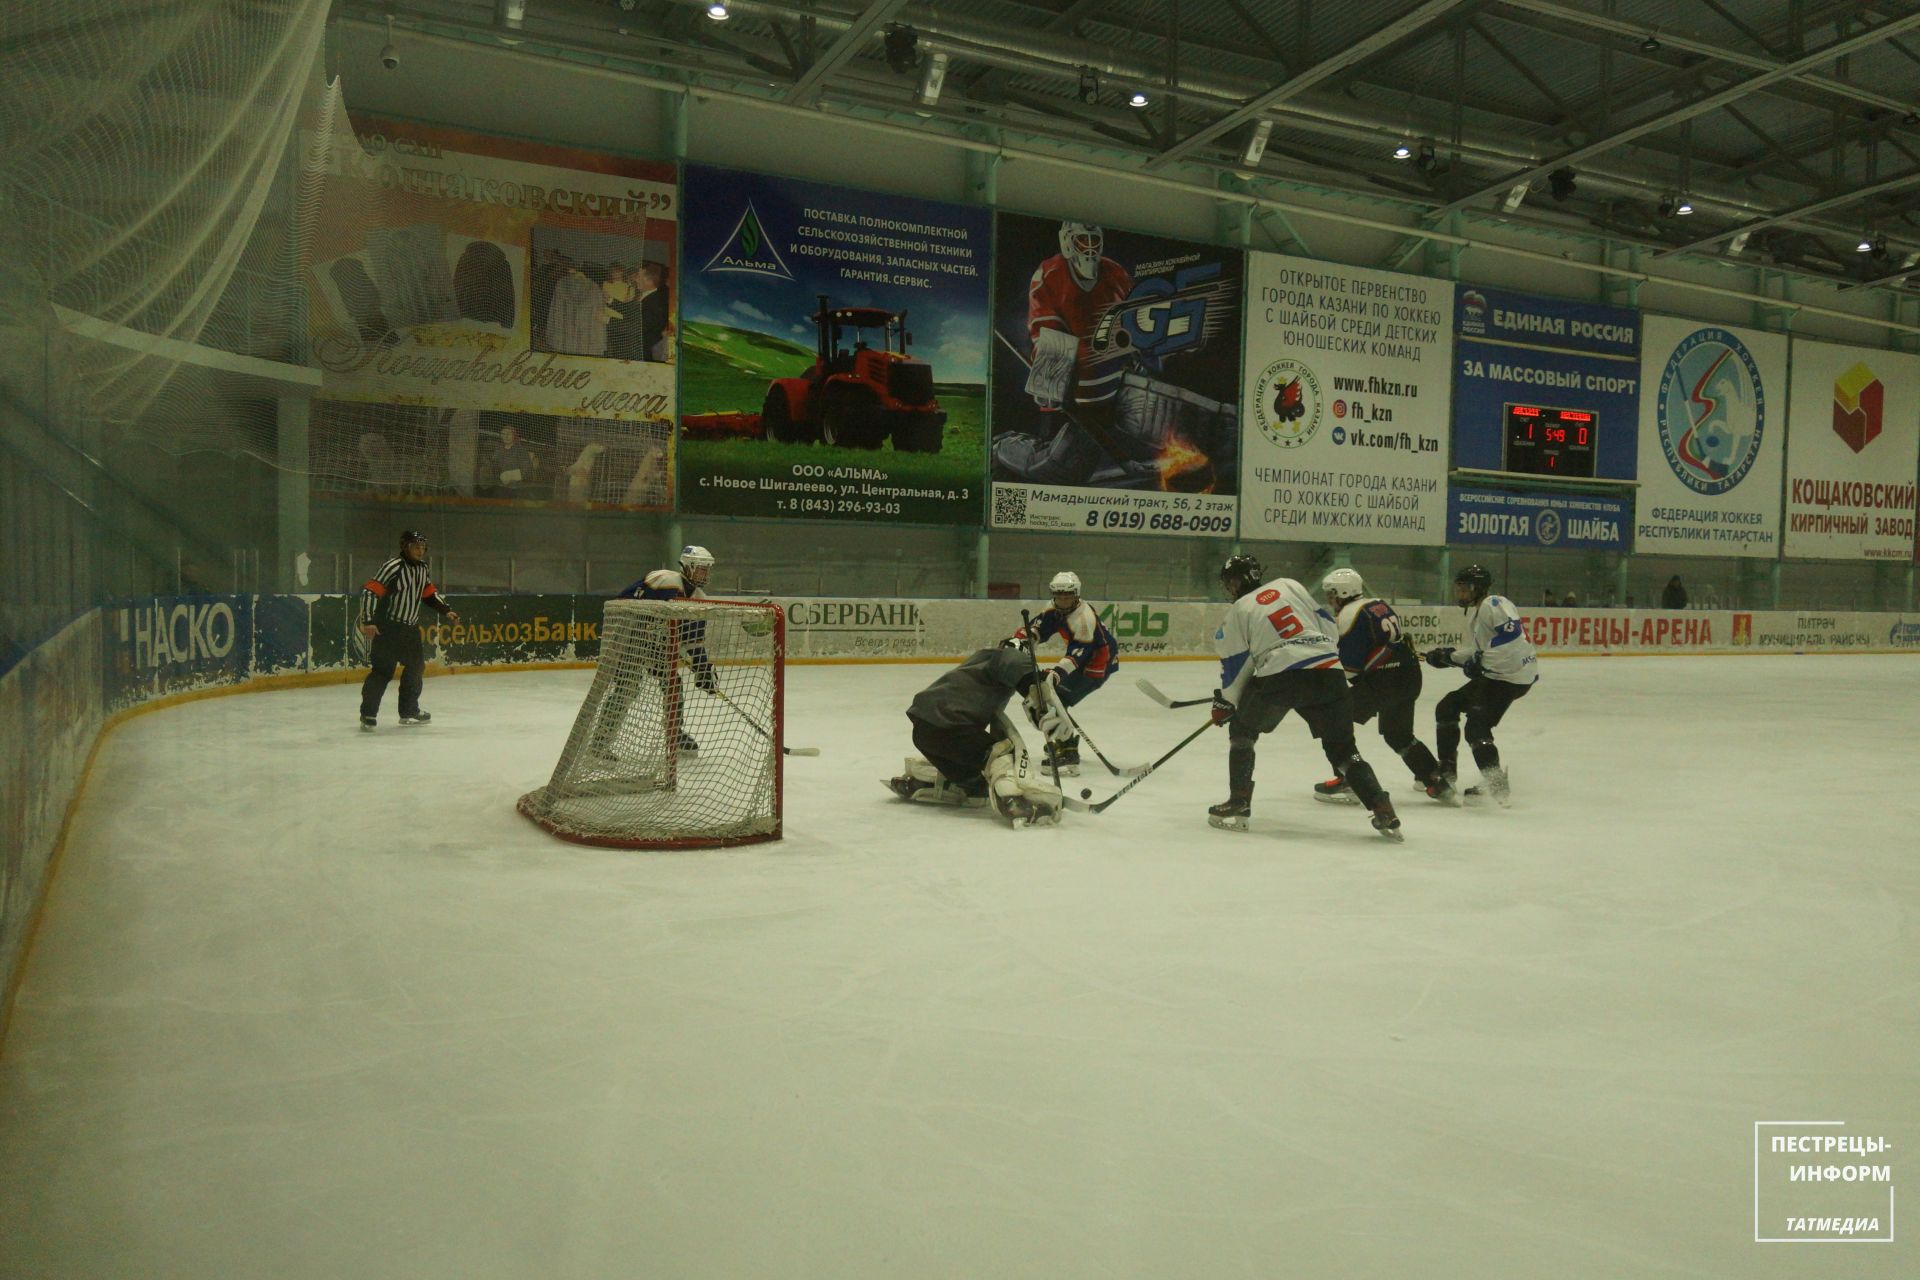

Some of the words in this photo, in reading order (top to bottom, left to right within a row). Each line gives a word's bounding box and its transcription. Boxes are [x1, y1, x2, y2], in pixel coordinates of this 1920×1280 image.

[804, 208, 857, 225] ПОСТАВКА
[859, 216, 968, 240] ПОЛНОКОМПЛЕКТНОЙ
[798, 226, 928, 251] СЕЛЬСКОХОЗЯЙСТВЕННОЙ
[930, 243, 972, 258] ТЕХНИКИ
[790, 243, 797, 254] И
[800, 244, 884, 265] ОБОРУДОВАНИЯ,
[886, 255, 939, 271] ЗАПАСНЫХ
[941, 262, 979, 277] ЧАСТЕЙ.
[840, 268, 891, 283] ГАРАНТИЯ.
[893, 275, 932, 289] СЕРВИС.
[1280, 269, 1346, 293] ОТКРЫТОЕ
[1352, 280, 1426, 304] ПЕРВЕНСТВО
[1262, 286, 1314, 308] ГОРОДА
[1319, 295, 1367, 316] КАЗАНИ
[1372, 303, 1389, 319] ПО
[1394, 306, 1440, 325] ХОККЕЮ
[1266, 308, 1273, 323] С
[1279, 310, 1336, 330] ШАЙБОЙ
[1341, 318, 1380, 337] СРЕДИ
[1385, 324, 1437, 344] ДЕТСКИХ
[1493, 309, 1565, 335] ЕДИНАЯ
[1571, 321, 1633, 344] РОССИЯ
[1283, 330, 1366, 354] ЮНОШЕСКИХ
[1371, 343, 1420, 362] КОМАНД
[1334, 376, 1418, 398] www.fhkzn.ru
[1463, 360, 1484, 378] ЗА
[1489, 363, 1581, 389] МАССОВЫЙ
[1585, 375, 1636, 395] СПОРТ
[1352, 401, 1392, 423] fh_kzn
[1350, 429, 1438, 453] vk.com/fh_kzn
[1578, 427, 1588, 445] 0
[792, 464, 825, 478] ООО
[827, 466, 888, 480] «АЛЬМА»
[1255, 467, 1334, 487] ЧЕМПИОНАТ
[1340, 473, 1387, 490] ГОРОДА
[1392, 476, 1437, 493] КАЗАНИ
[713, 476, 756, 489] Новое
[759, 479, 837, 495] Шигалеево,
[840, 484, 859, 497] ул.
[862, 484, 946, 500] Центральная,
[947, 489, 959, 501] д.
[961, 489, 969, 500] 3
[1031, 489, 1130, 507] Мамадышский
[1132, 496, 1169, 511] тракт,
[1172, 498, 1191, 512] 56,
[1194, 499, 1202, 510] 2
[1205, 501, 1233, 512] этаж
[1274, 489, 1292, 504] ПО
[1298, 491, 1349, 508] ХОККЕЮ
[1355, 494, 1362, 508] С
[1367, 494, 1419, 511] ШАЙБОЙ
[1792, 478, 1915, 510] КОЩАКОВСКИЙ
[790, 499, 798, 510] 8
[800, 499, 835, 513] (843)
[837, 501, 900, 515] 296-93-03
[1264, 508, 1307, 526] СРЕДИ
[1312, 512, 1372, 528] МУЖСКИХ
[1377, 515, 1425, 531] КОМАНД
[1652, 508, 1718, 523] ФЕДЕРАЦИЯ
[1721, 511, 1762, 525] ХОККЕЯ
[1086, 510, 1098, 527] 8
[1103, 511, 1145, 529] (919)
[1150, 513, 1232, 532] 688-0909
[1458, 512, 1529, 537] ЗОЛОТАЯ
[1567, 516, 1619, 542] ШАЙБА
[1790, 513, 1868, 535] КИРПИЧНЫЙ
[1875, 517, 1913, 540] ЗАВОД
[1639, 525, 1710, 541] РЕСПУБЛИКИ
[1713, 529, 1773, 544] ТАТАРСТАН
[788, 603, 925, 626] СБЕРБАНК
[1267, 605, 1304, 639] 5
[135, 602, 235, 670] НАСКО
[419, 616, 598, 645] ссельхозБанк
[1520, 617, 1712, 648] ЕСТРЕЦЫ-АРЕНА
[1018, 749, 1029, 779] CCM
